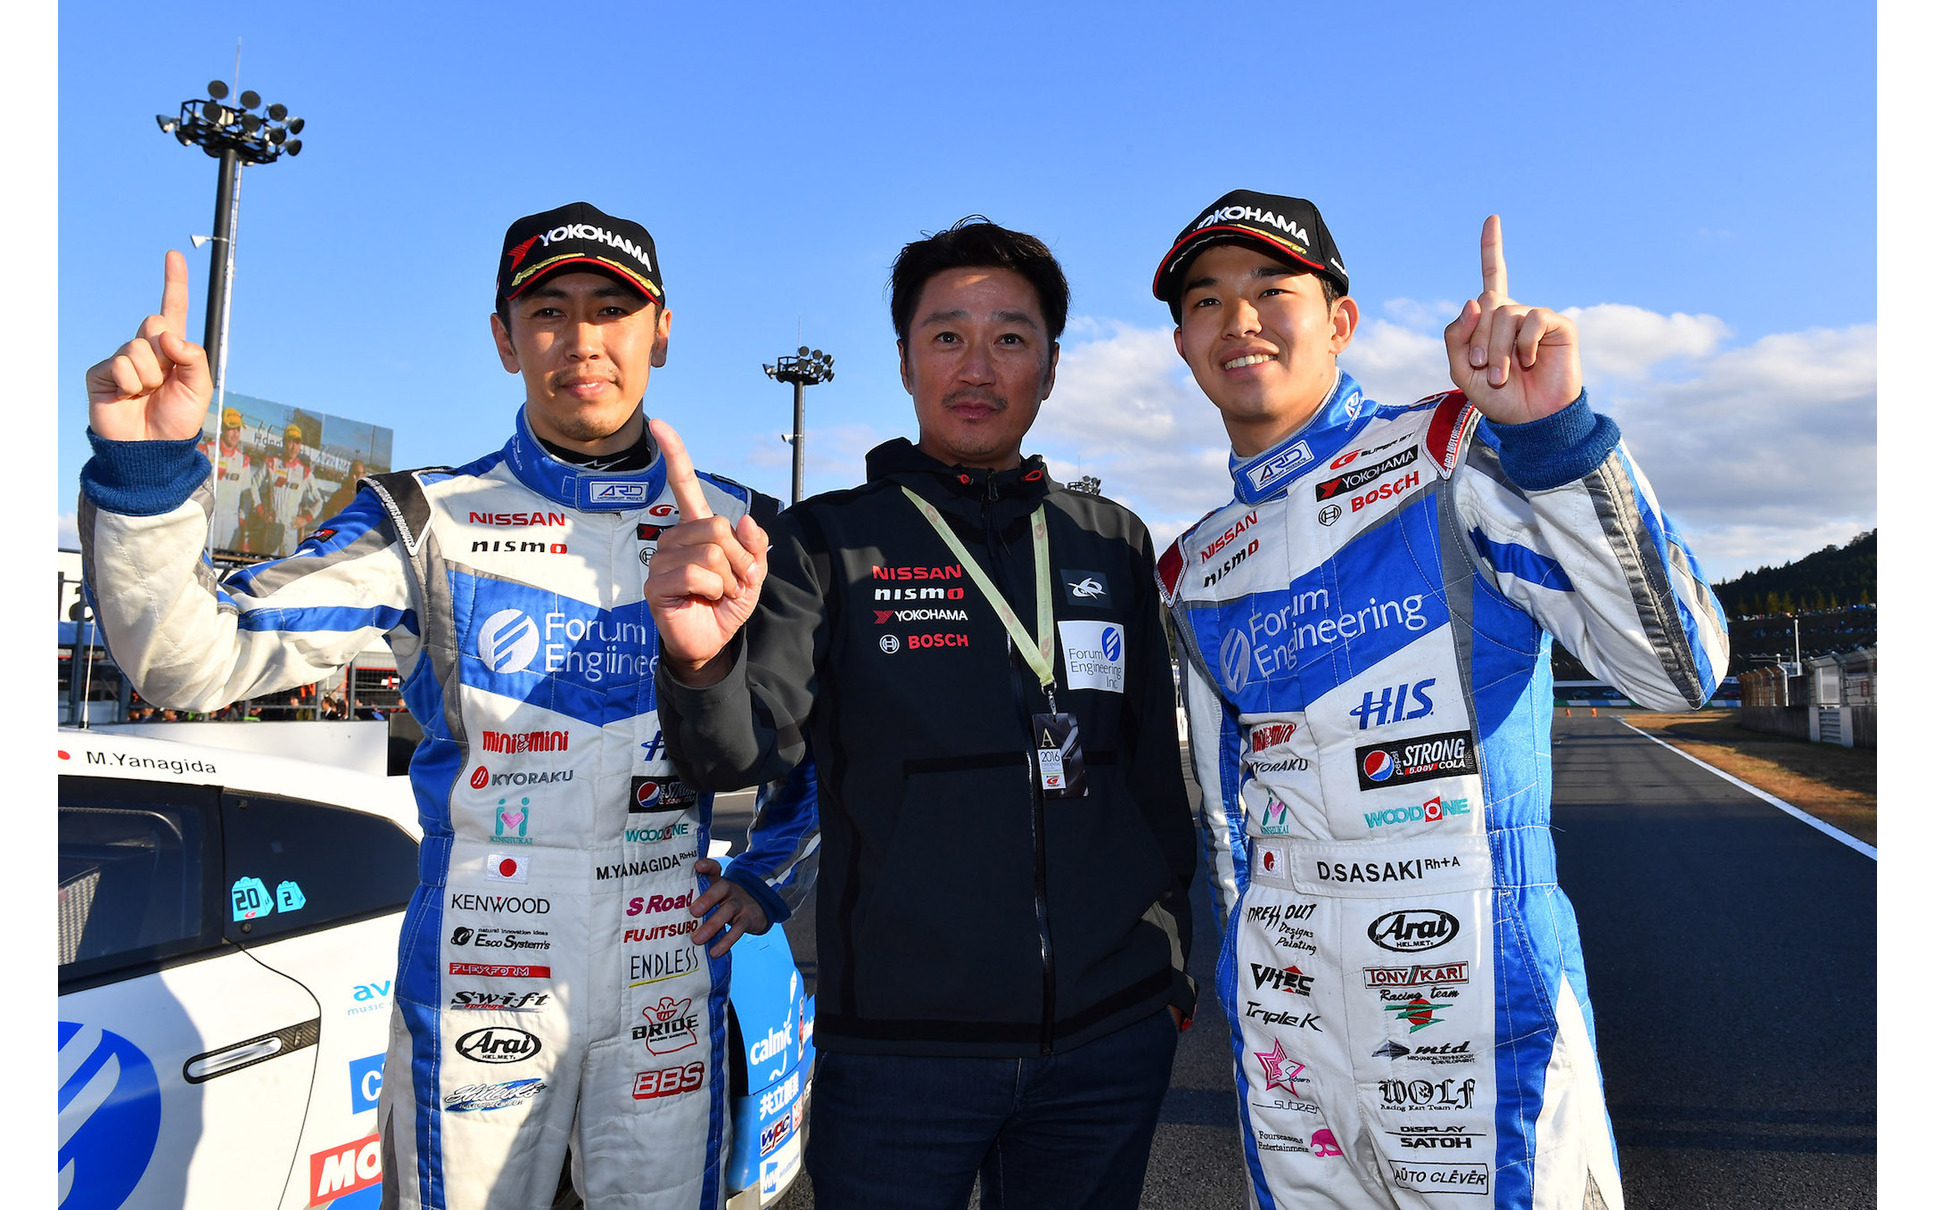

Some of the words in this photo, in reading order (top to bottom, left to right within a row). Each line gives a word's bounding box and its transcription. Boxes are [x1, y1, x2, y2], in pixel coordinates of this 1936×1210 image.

[1192, 206, 1310, 247] OKOHAMA
[539, 223, 652, 273] YOKOHAMA
[1341, 450, 1415, 490] YOKOHAMA
[1351, 470, 1419, 513] BOSCH
[469, 511, 566, 527] NISSAN
[471, 540, 568, 555] nismo
[1200, 510, 1258, 565] NISSAN
[872, 563, 962, 581] NISSAN
[1203, 538, 1260, 588] nismo
[874, 587, 965, 601] nismo
[894, 609, 969, 622] YOKOHAMA
[1248, 588, 1330, 646] Forum
[545, 612, 647, 645] Forum
[1253, 594, 1429, 678] Engineering
[908, 633, 969, 650] BOSCH
[1068, 648, 1103, 660] Forum
[1070, 660, 1122, 680] Engineering
[1106, 676, 1118, 689] Inc
[1040, 727, 1056, 748] A
[86, 751, 217, 775] M.Yanagida
[1040, 751, 1060, 763] 2016
[1391, 751, 1404, 776] pepsi
[1402, 738, 1466, 767] STRONG
[1438, 758, 1466, 770] COLA
[491, 769, 574, 787] KYORAKU
[1364, 796, 1470, 829] WOODONE
[625, 823, 689, 843] WOODONE
[595, 853, 682, 881] M.YANAGIDA
[1316, 859, 1424, 884] D.SASAKI
[233, 887, 261, 912] 20
[283, 891, 294, 907] 2
[451, 893, 551, 915] KENWOOD
[645, 889, 694, 915] Road
[1284, 903, 1318, 921] OUT
[623, 920, 698, 943] FUJITSUBO
[1278, 921, 1314, 940] Designs
[1378, 913, 1454, 941] Arai
[475, 933, 503, 947] Esco
[503, 935, 551, 950] System's
[1275, 936, 1317, 956] Painting
[630, 946, 699, 980] ENDLESS
[353, 980, 391, 1002] av
[1379, 989, 1423, 1002] Racing
[347, 1001, 385, 1016] music
[1247, 1000, 1298, 1027] Triple
[1299, 1012, 1324, 1033] K
[631, 1014, 699, 1041] BRIDE
[461, 1031, 532, 1054] Arai
[750, 1021, 793, 1066] calmic
[1415, 1041, 1471, 1054] mtd
[633, 1061, 704, 1100] BBS
[1380, 1103, 1406, 1112] Racing
[1400, 1125, 1466, 1133] DISPLAY
[1400, 1137, 1472, 1149] SATOH
